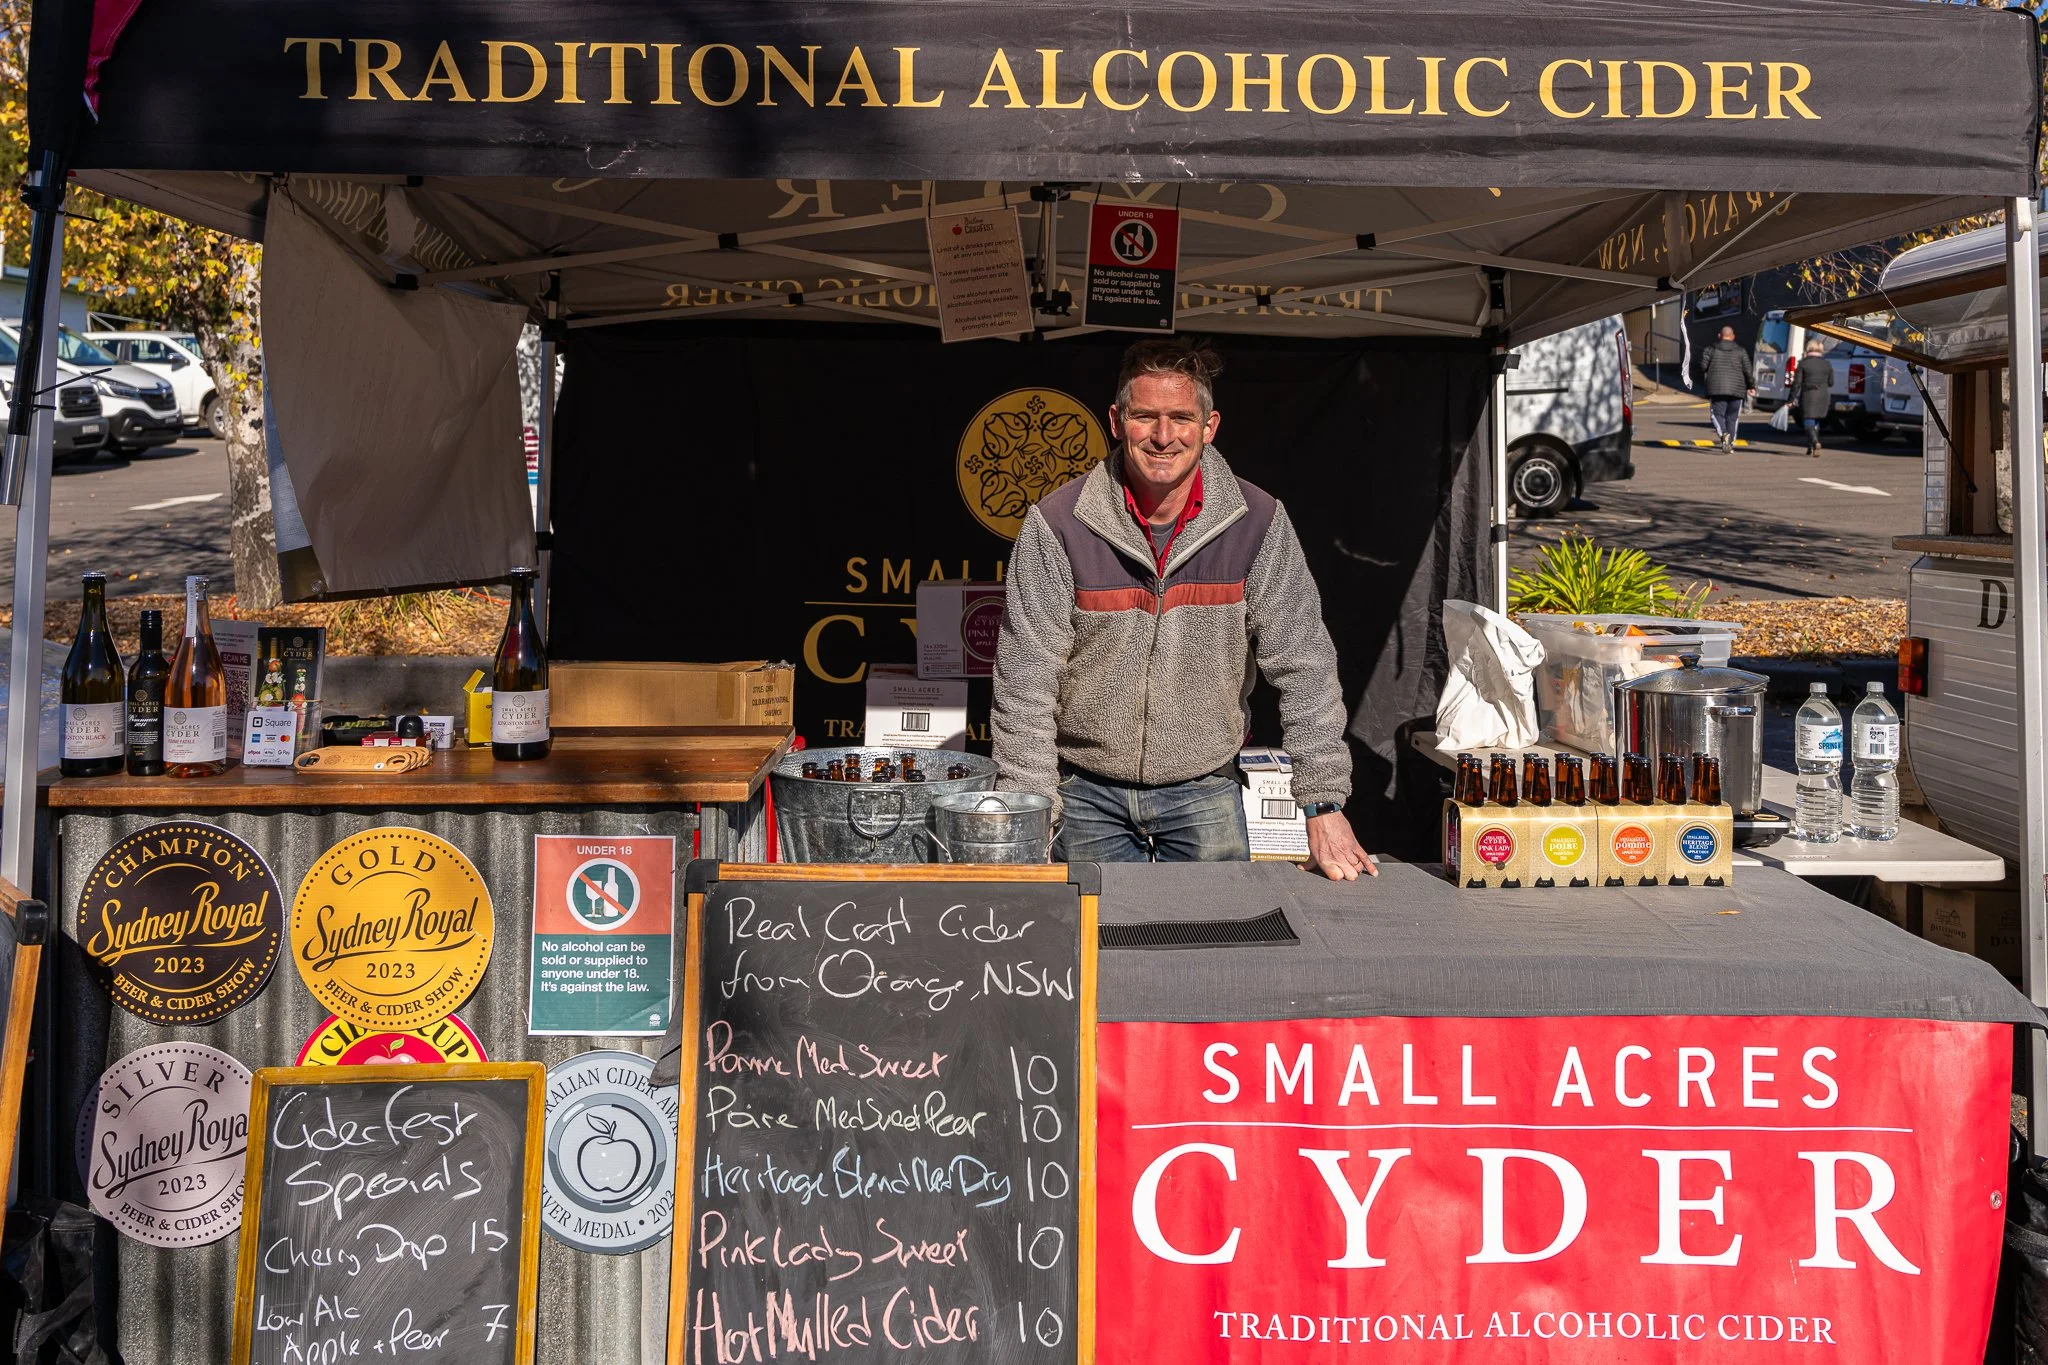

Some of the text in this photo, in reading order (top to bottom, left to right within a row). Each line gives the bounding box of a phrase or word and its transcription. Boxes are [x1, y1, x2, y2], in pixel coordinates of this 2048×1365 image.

[284, 37, 1822, 120] TRADITIONAL ALCOHOLIC CIDER
[1118, 210, 1143, 218] UNDER
[1092, 287, 1119, 295] anyone
[1121, 288, 1143, 296] under
[1093, 277, 1109, 285] sold
[1120, 279, 1152, 289] supplied
[1106, 270, 1133, 278] alcohol
[1092, 293, 1103, 301] It's
[1104, 295, 1131, 303] against
[264, 718, 292, 727] Square
[1818, 741, 1838, 750] SPRING
[105, 838, 251, 888] CHAMPION
[331, 845, 436, 886] GOLD
[576, 845, 632, 855] UNDER 18
[87, 881, 269, 967] Sydney Royal
[302, 887, 479, 972] Sydney Royal
[725, 896, 811, 945] Real
[939, 904, 1034, 943] Cider
[154, 957, 205, 974] 2023
[541, 941, 646, 952] No alcohol can be
[541, 955, 648, 969] sold or supplied to
[113, 958, 256, 1010] BEER & CIDER SHOW
[366, 962, 416, 979] 2023
[541, 969, 640, 982] anyone under 18.
[541, 981, 650, 995] It's against the law.
[721, 949, 811, 1000] from
[983, 960, 1075, 1001] NSW
[324, 967, 464, 1016] BEER & CIDER SHOW
[102, 1061, 225, 1119] SILVER
[1009, 1046, 1059, 1100] 10
[1202, 1041, 1840, 1110] SMALL ACRES
[1018, 1103, 1063, 1143] 10
[92, 1098, 249, 1199] Sydney Roya
[158, 1173, 208, 1196] 2023
[703, 1147, 829, 1206] Heritage
[832, 1146, 912, 1199] Blend
[951, 1154, 1012, 1208] Dry
[1027, 1157, 1070, 1202] 10
[119, 1175, 246, 1231] BEER & CIDER SHO
[1131, 1141, 1922, 1276] CYDER
[470, 1218, 510, 1254] 15
[573, 1217, 637, 1240] MEDAL
[698, 1210, 766, 1269] Pink
[775, 1225, 863, 1282] Lady
[1017, 1223, 1065, 1270] 10
[257, 1294, 360, 1331] Low Alc
[693, 1288, 764, 1365] Hot
[882, 1285, 981, 1351] Cider
[1018, 1301, 1064, 1348] 10
[1213, 1310, 1837, 1346] TRADITIONAL ALCOHOLIC CIDER
[283, 1331, 360, 1365] Apple
[481, 1303, 511, 1343] 7
